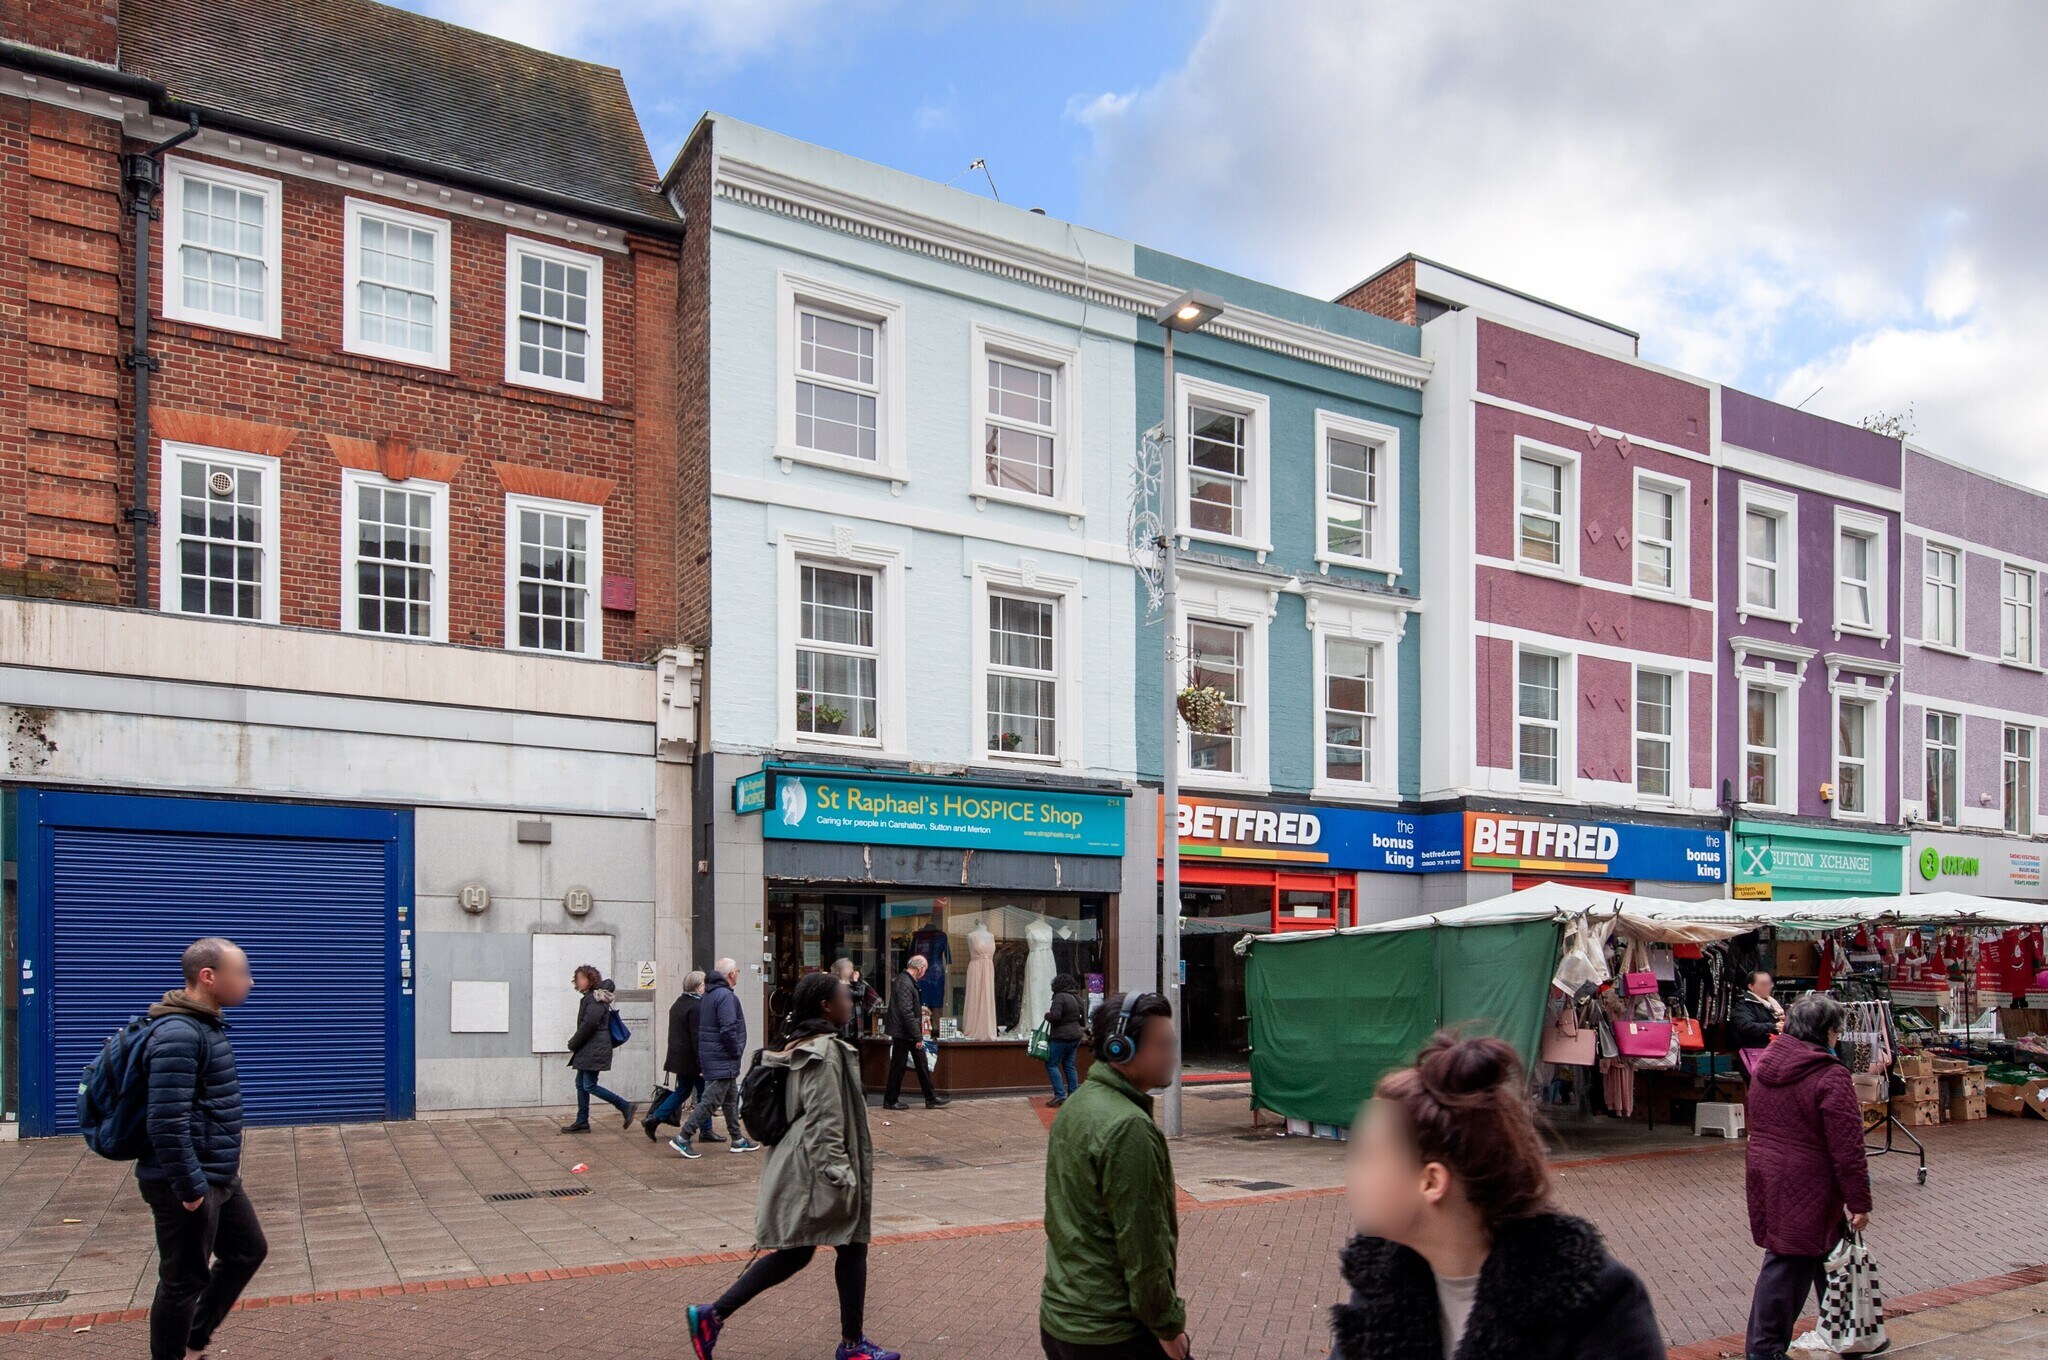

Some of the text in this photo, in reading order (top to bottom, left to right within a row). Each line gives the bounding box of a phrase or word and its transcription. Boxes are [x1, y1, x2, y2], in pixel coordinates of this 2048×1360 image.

[817, 785, 1083, 830] St Raphael's HOSPICE Shop
[1107, 799, 1121, 807] 214
[816, 816, 841, 827] Caring
[842, 817, 852, 826] for
[854, 819, 879, 829] people
[880, 819, 887, 828] in
[888, 820, 928, 831] Carshalton,
[929, 823, 952, 832] Sutton
[967, 825, 991, 834] Merton
[1178, 804, 1321, 845] BETFRED
[1397, 820, 1414, 834] the
[1372, 833, 1414, 850] bonus
[1472, 818, 1619, 860] BETFRED
[1706, 835, 1720, 848] the
[1385, 851, 1414, 868] king
[1421, 850, 1461, 859] betfred.com
[1686, 848, 1720, 862] bonus
[1743, 846, 1770, 875] X
[1772, 850, 1870, 871] SUTTON XCHANGE
[1697, 863, 1721, 879] king
[1942, 856, 1979, 876] OXFAM
